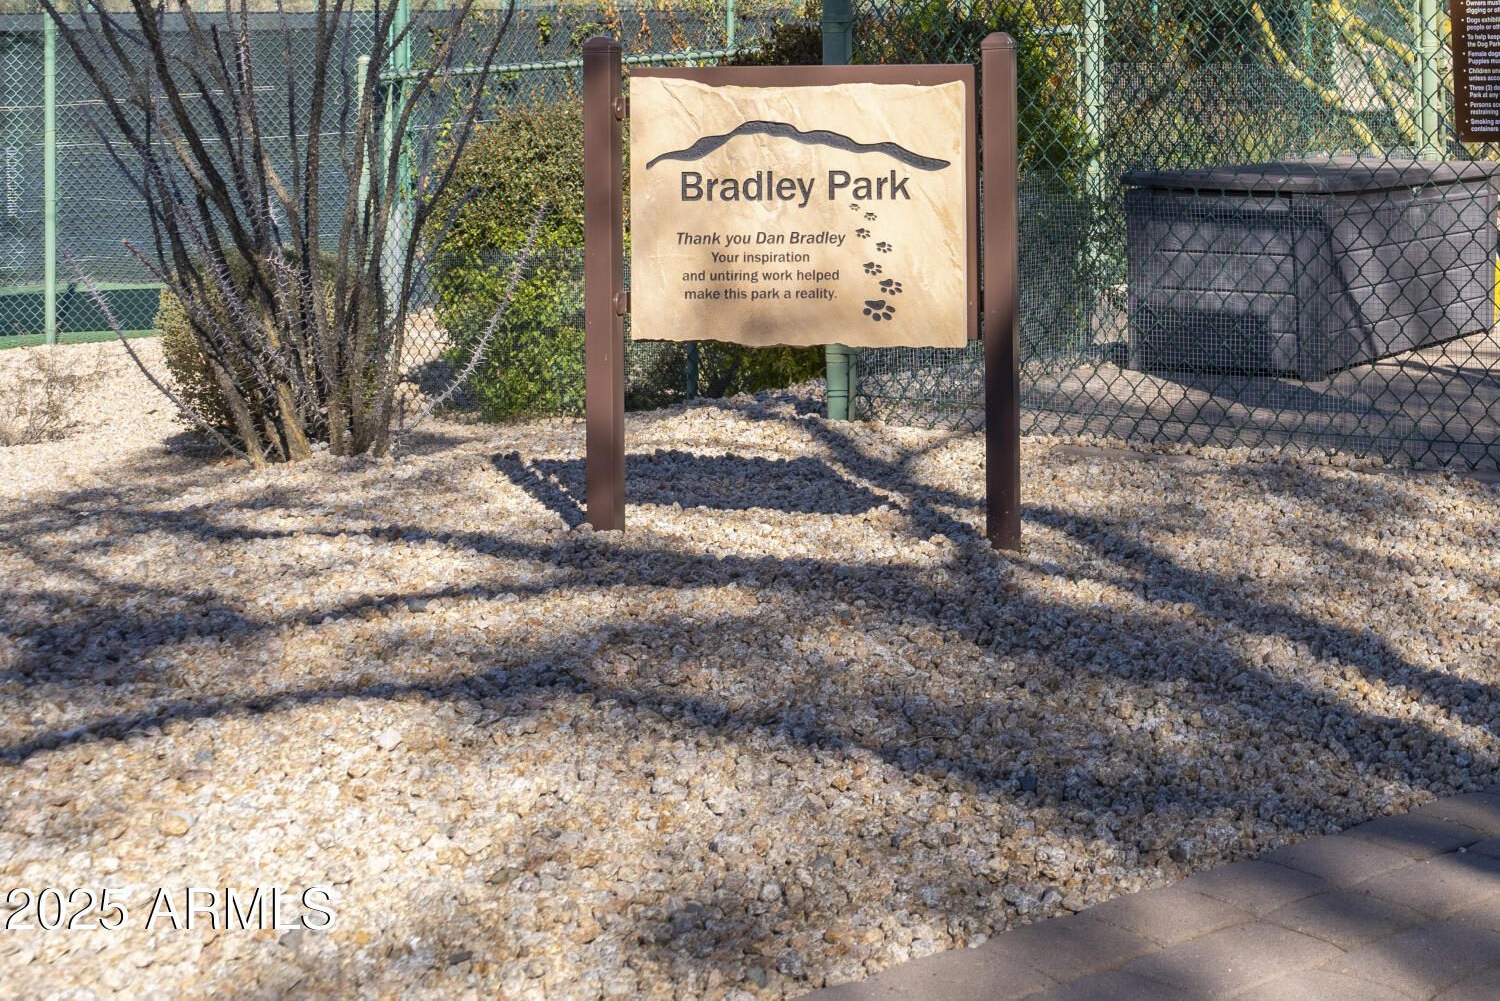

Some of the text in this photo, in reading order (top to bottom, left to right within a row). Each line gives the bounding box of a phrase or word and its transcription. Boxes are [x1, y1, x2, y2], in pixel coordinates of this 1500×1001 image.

[681, 170, 911, 208] Bradley Park
[676, 231, 846, 248] Thank you Dan Bradley
[711, 251, 810, 266] Your inspiration
[682, 269, 839, 283] and untiring work helped
[684, 288, 837, 302] make this park a reality.
